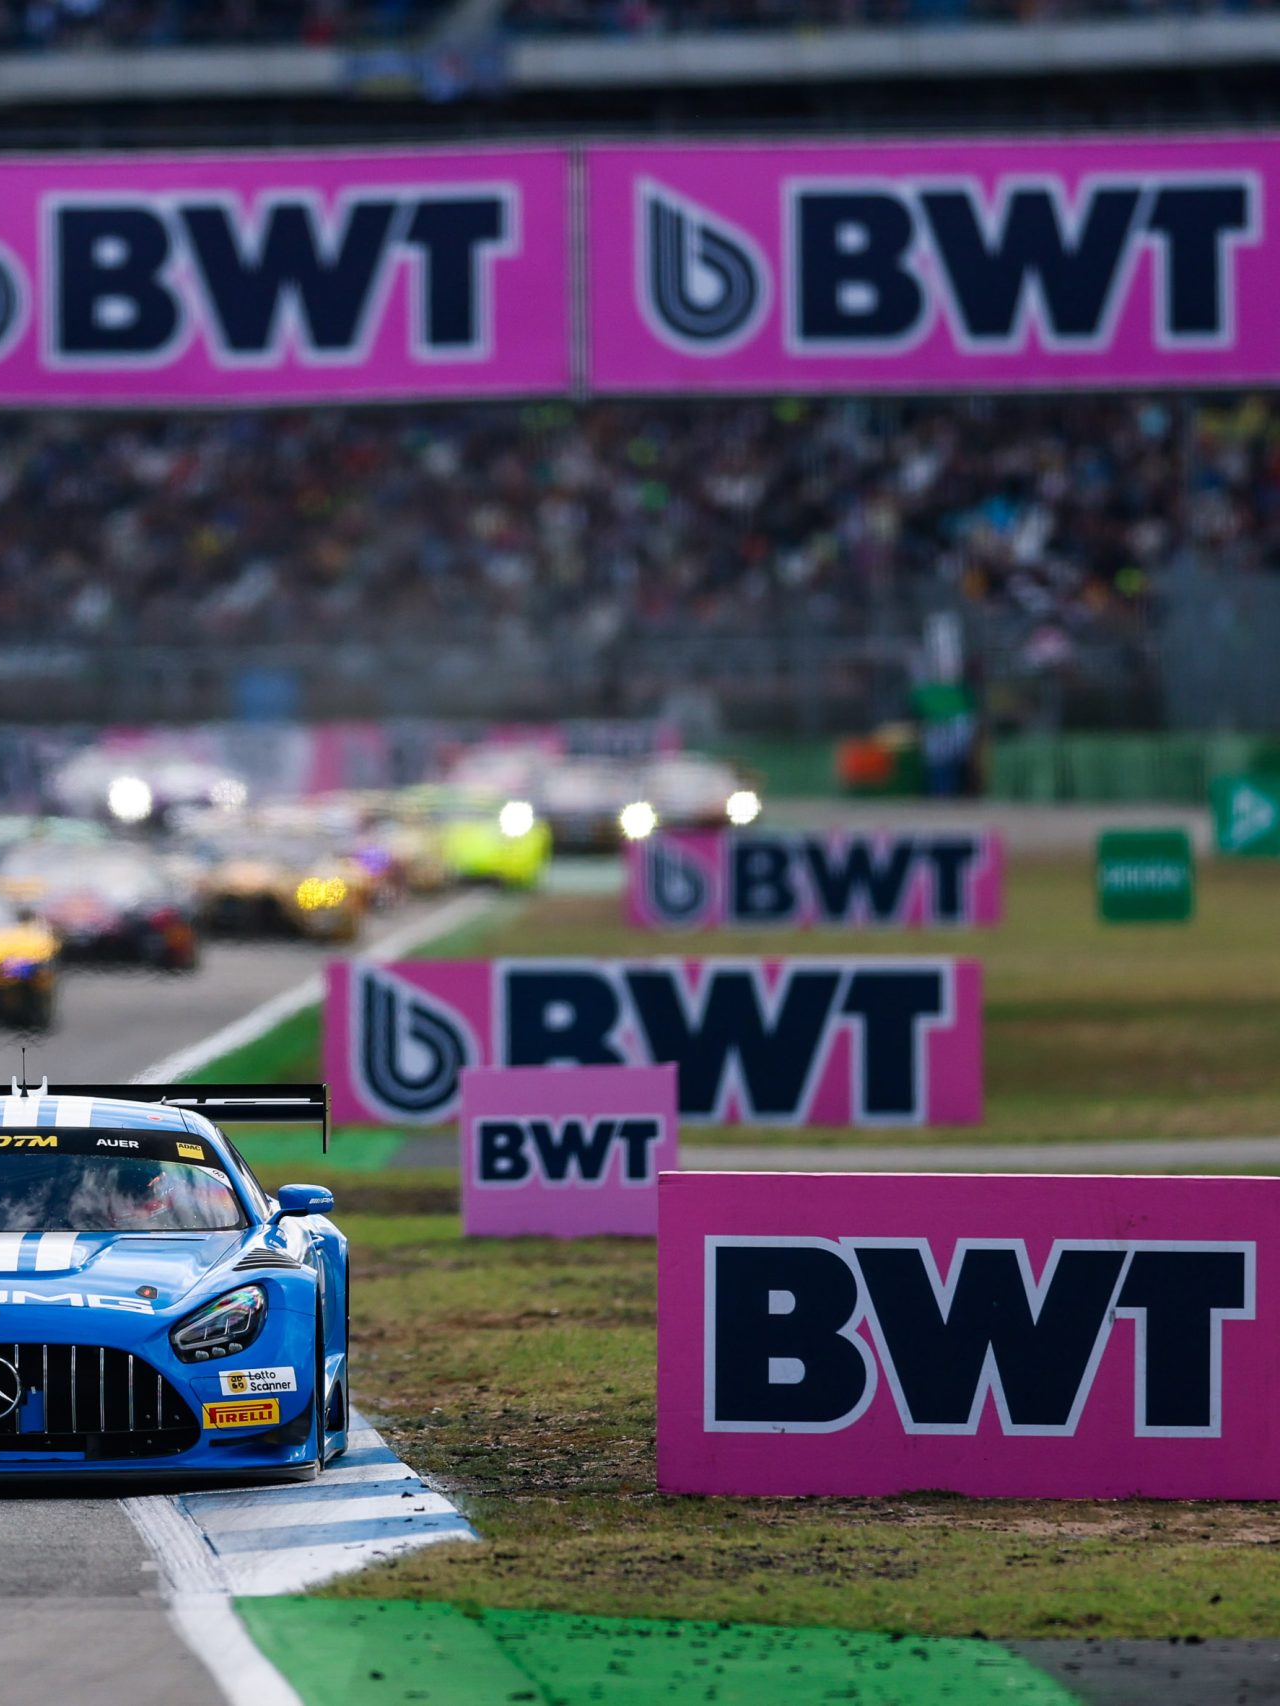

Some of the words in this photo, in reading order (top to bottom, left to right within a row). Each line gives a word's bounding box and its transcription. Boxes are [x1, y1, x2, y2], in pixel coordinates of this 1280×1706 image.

[42, 184, 518, 367] BWT
[784, 173, 1258, 355] BWT
[728, 832, 980, 925] BWT
[96, 1138, 140, 1149] AUER
[178, 1143, 201, 1151] ADAC
[476, 1116, 664, 1186] BWT
[705, 1235, 1256, 1437] BWT
[248, 1371, 276, 1381] Lotto
[250, 1381, 291, 1391] Scanner
[209, 1403, 273, 1424] PIRELLI
